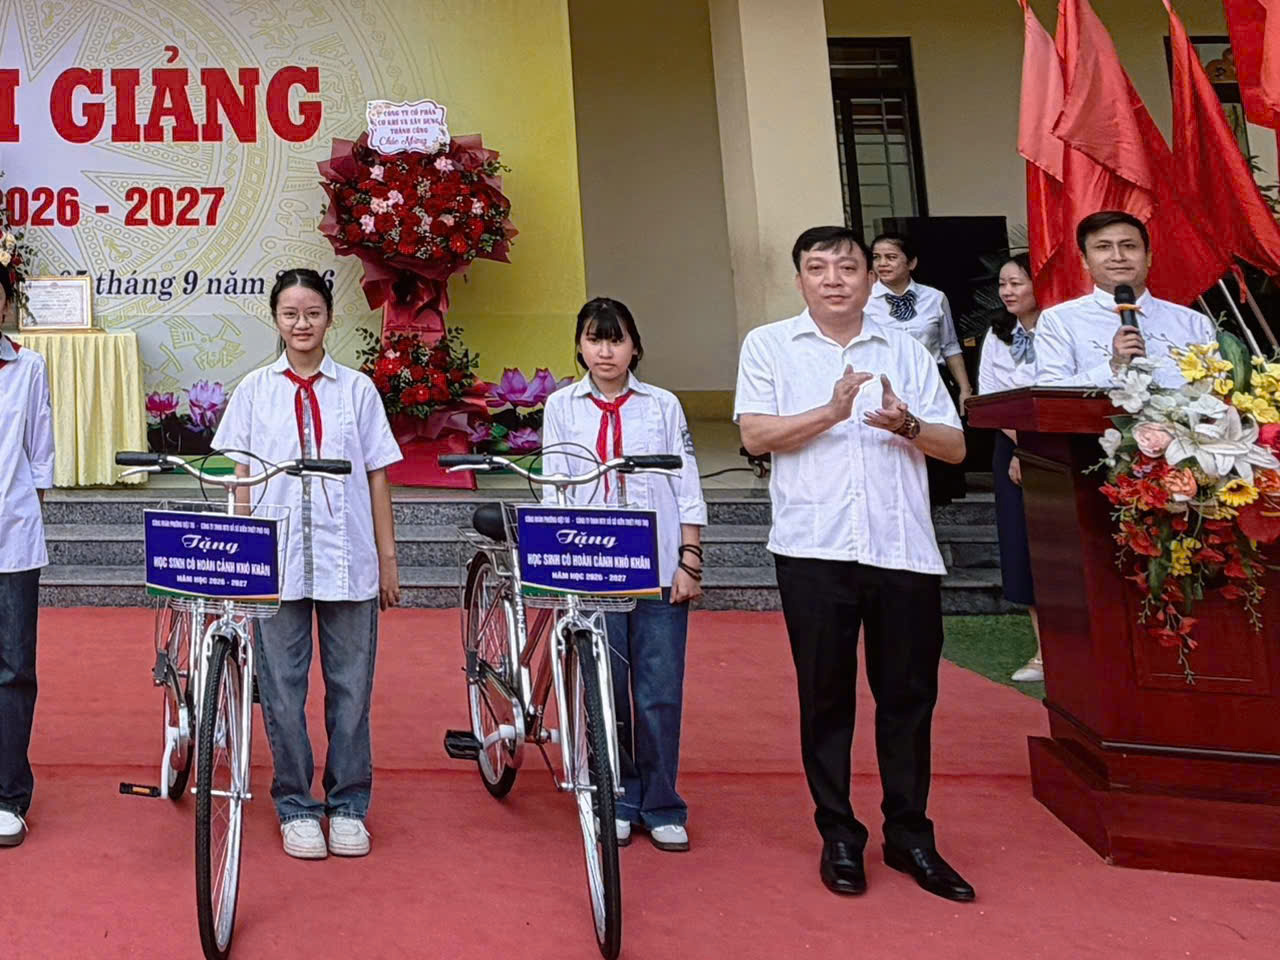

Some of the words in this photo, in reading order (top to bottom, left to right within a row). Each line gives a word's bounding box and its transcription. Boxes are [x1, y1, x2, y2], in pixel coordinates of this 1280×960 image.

[51, 46, 322, 143] GIẢNG
[96, 205, 109, 214] -
[124, 187, 225, 227] 2027
[96, 269, 176, 301] tháng
[182, 270, 199, 295] 9
[205, 271, 265, 295] năm
[182, 534, 240, 554] Tặng
[555, 529, 618, 548] Tặng
[153, 556, 168, 570] HỌC
[169, 557, 185, 569] SINH
[187, 557, 196, 570] CÓ
[196, 558, 216, 572] HOÀN
[236, 561, 250, 575] KHÓ
[527, 553, 542, 568] HỌC
[543, 554, 560, 566] SINH
[562, 552, 571, 566] CÓ
[572, 554, 592, 567] HOÀN
[614, 554, 630, 569] KHÓ
[194, 576, 207, 585] HỌC
[570, 572, 584, 581] HỌC
